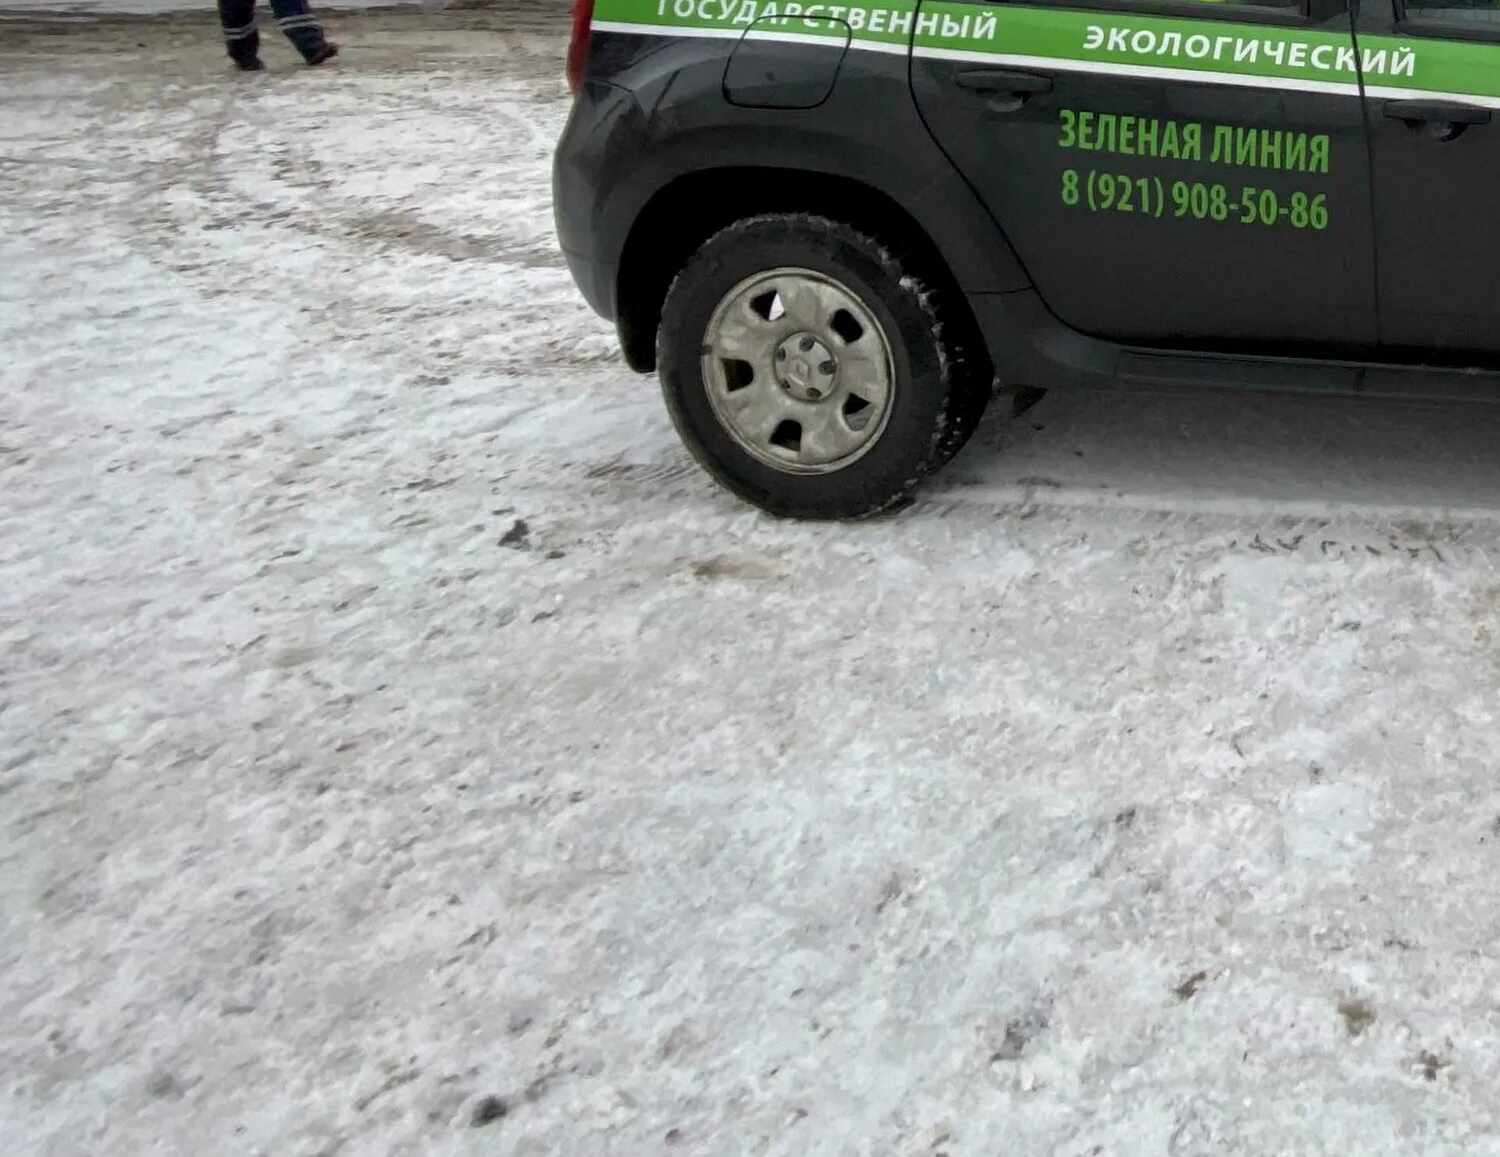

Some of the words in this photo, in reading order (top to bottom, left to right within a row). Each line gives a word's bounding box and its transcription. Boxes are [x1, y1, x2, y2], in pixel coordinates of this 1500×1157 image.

[1083, 25, 1417, 78] ЭКОЛОГИЧЕСКИЙ
[1059, 109, 1202, 161] ЗЕЛЕНАЯ
[1210, 126, 1330, 174] ЛИНИЯ
[1062, 169, 1078, 206] 8
[1087, 171, 1164, 218] (921)
[1172, 181, 1328, 230] 908-50-86
